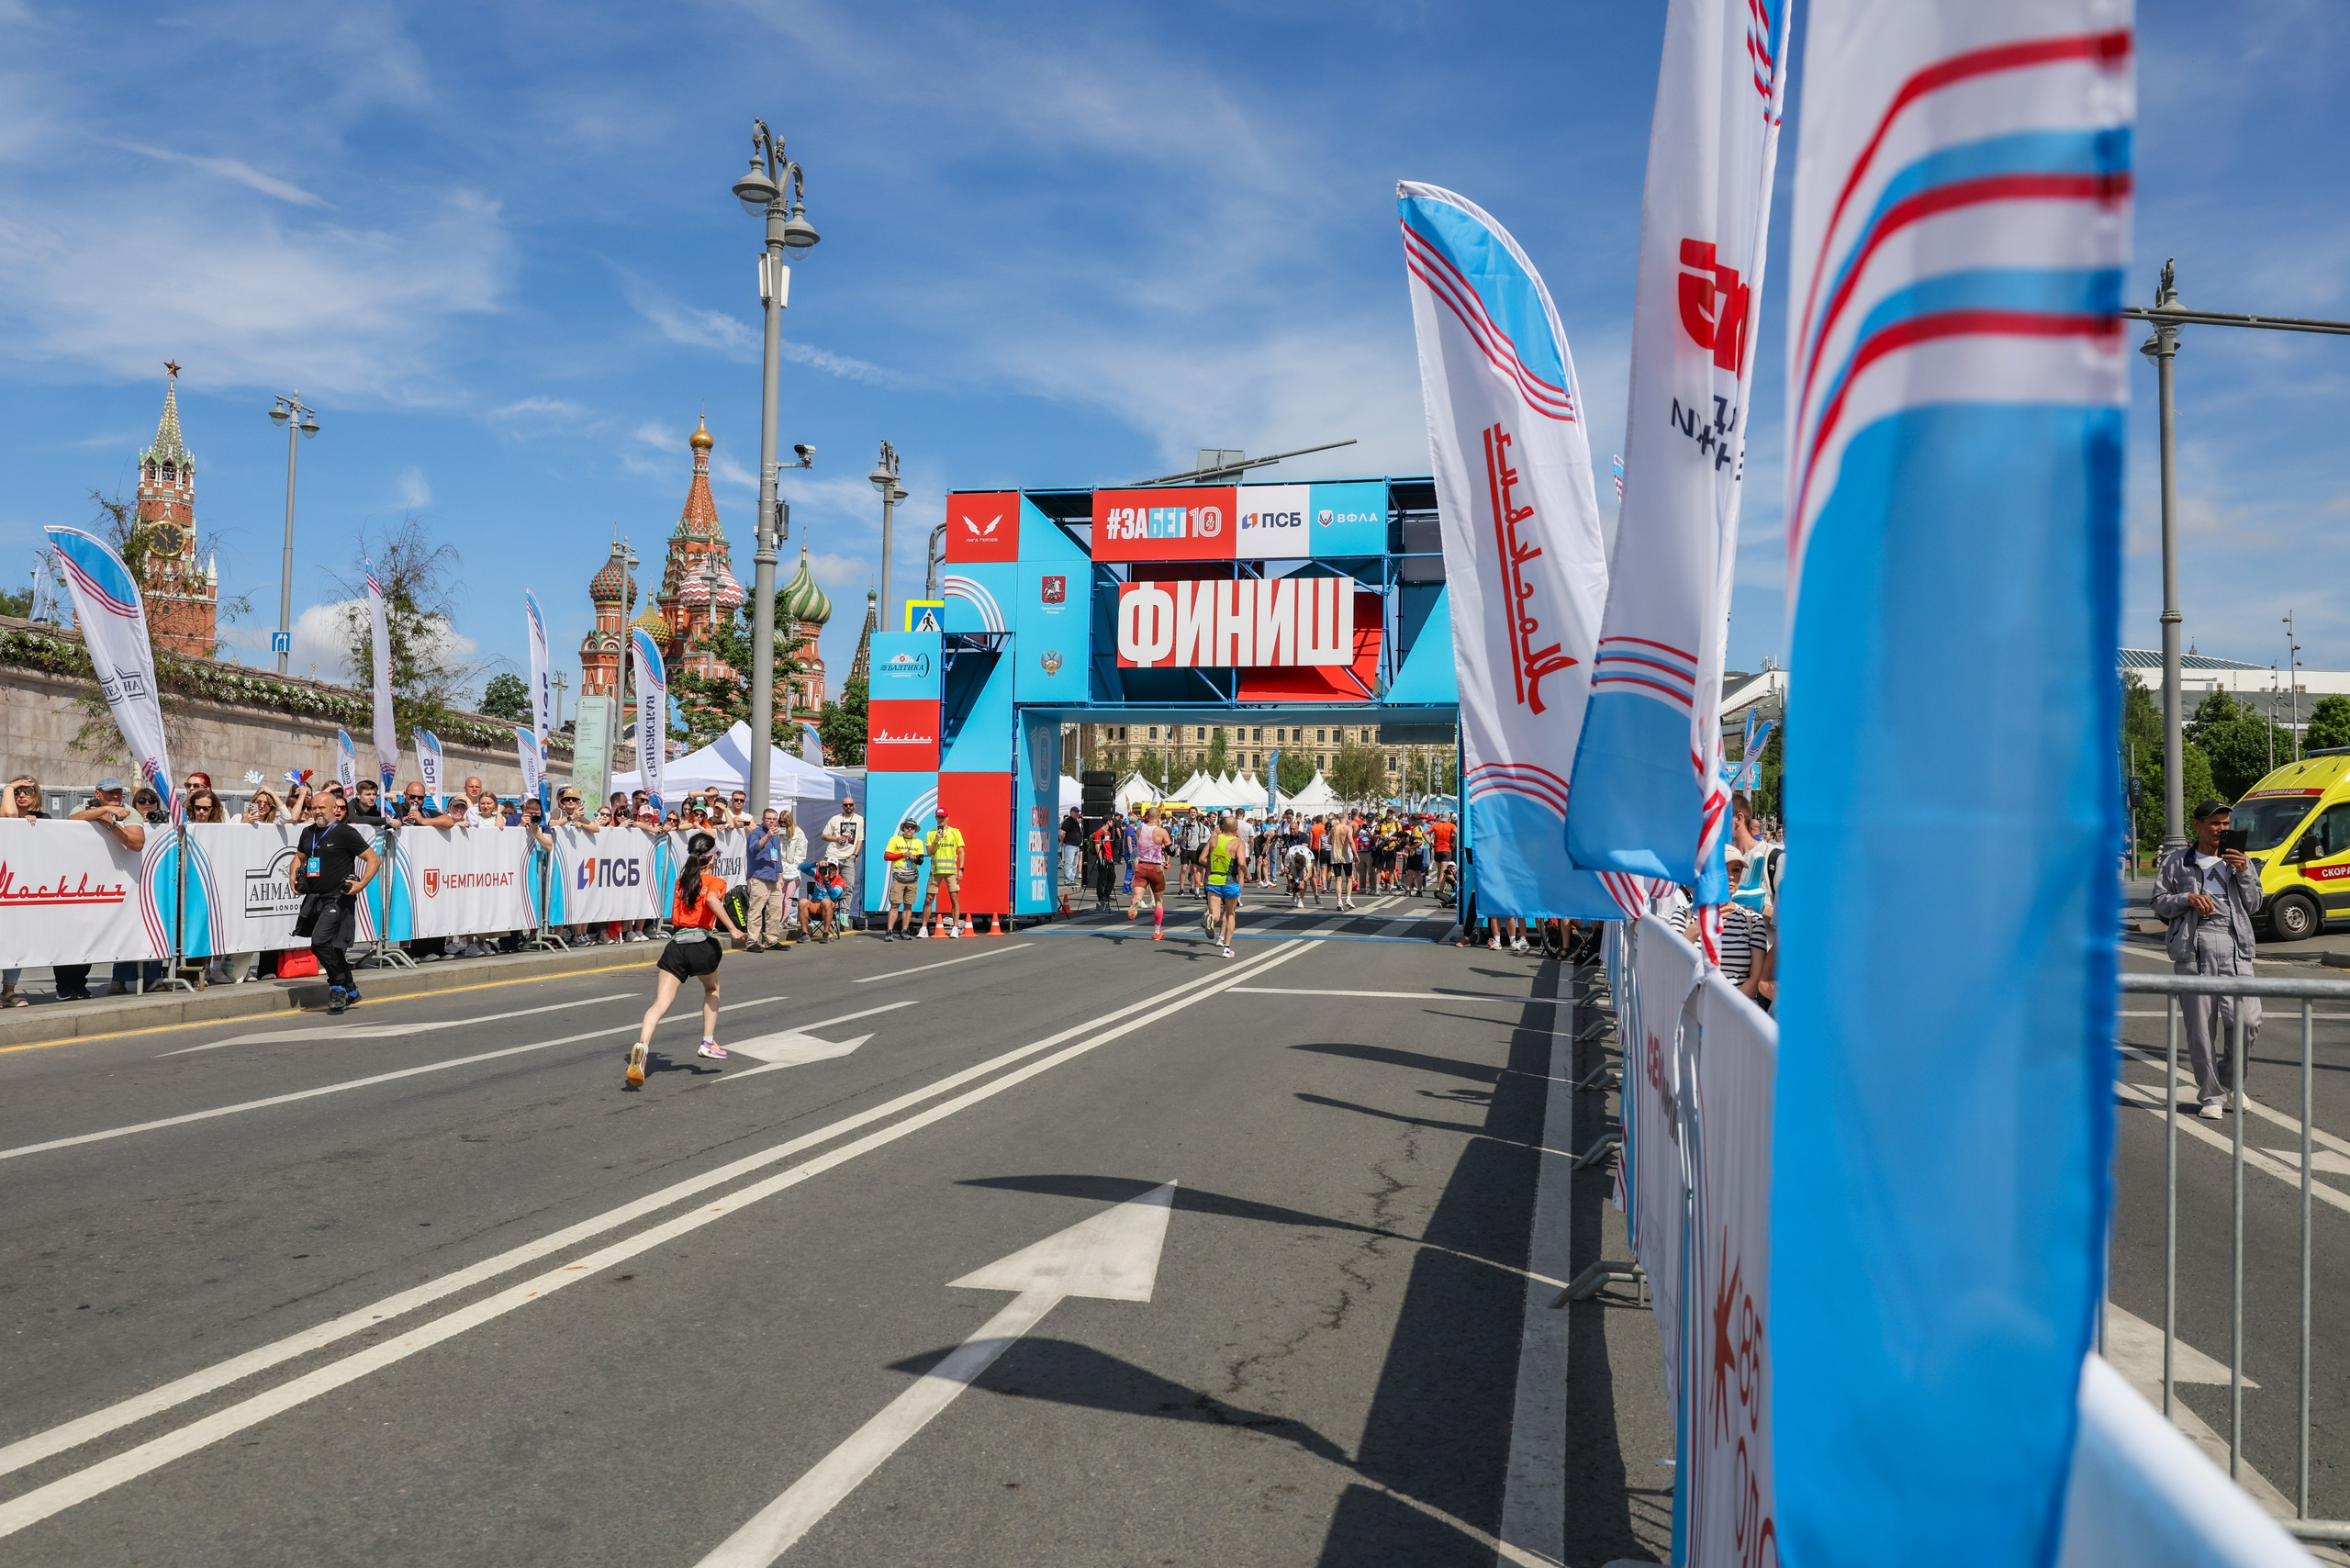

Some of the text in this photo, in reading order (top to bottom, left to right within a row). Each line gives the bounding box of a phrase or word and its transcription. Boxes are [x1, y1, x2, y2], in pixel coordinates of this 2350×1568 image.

[1262, 511, 1302, 528] ПСБ
[1337, 511, 1378, 523] ВФЛА
[1117, 577, 1355, 667] ФИНИШ
[2255, 789, 2307, 797] РЕАНИМАЦИЯ
[442, 871, 514, 889] ЧЕМПИОНАТ
[598, 857, 641, 888] ПСБ
